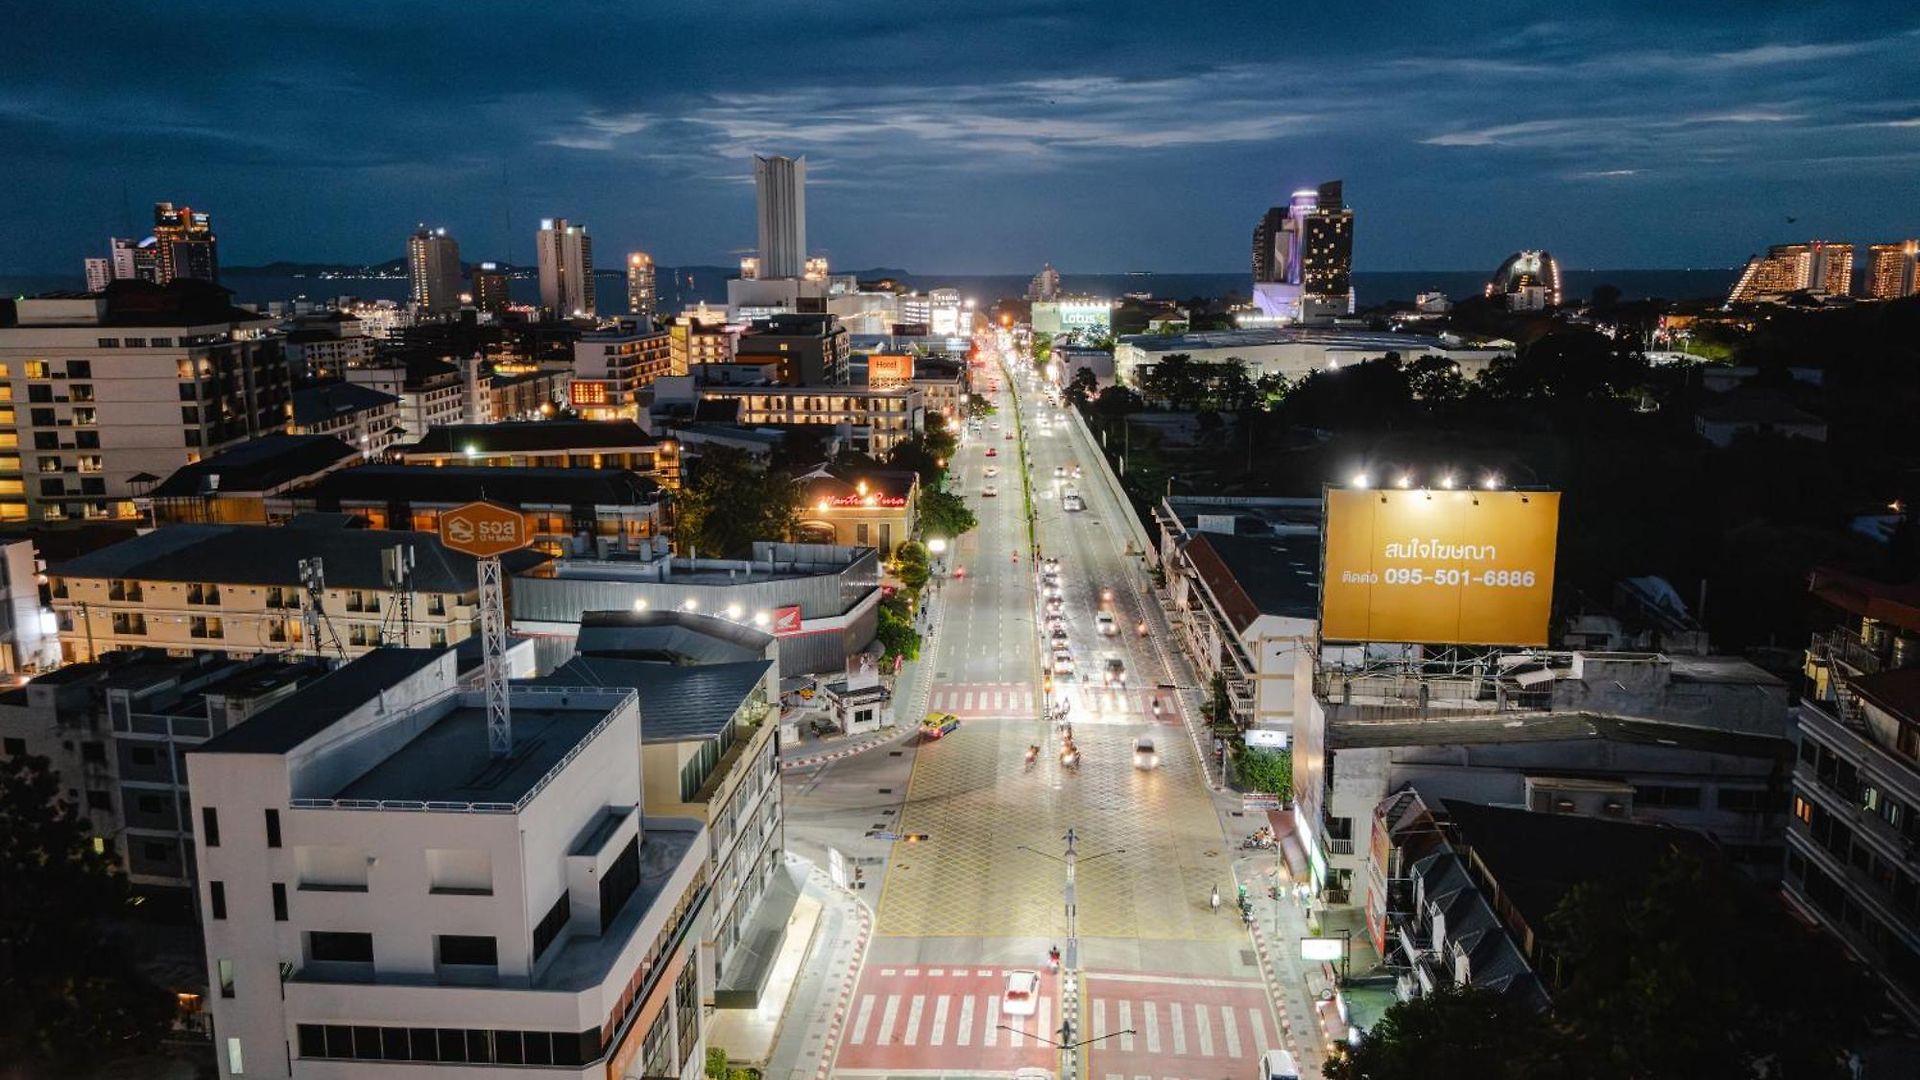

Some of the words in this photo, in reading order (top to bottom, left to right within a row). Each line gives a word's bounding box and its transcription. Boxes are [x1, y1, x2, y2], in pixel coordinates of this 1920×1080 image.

[1385, 538, 1496, 560] สนใจโฆษณา
[1341, 569, 1378, 585] ติดต่อ
[1384, 568, 1535, 587] 095-501-6886
